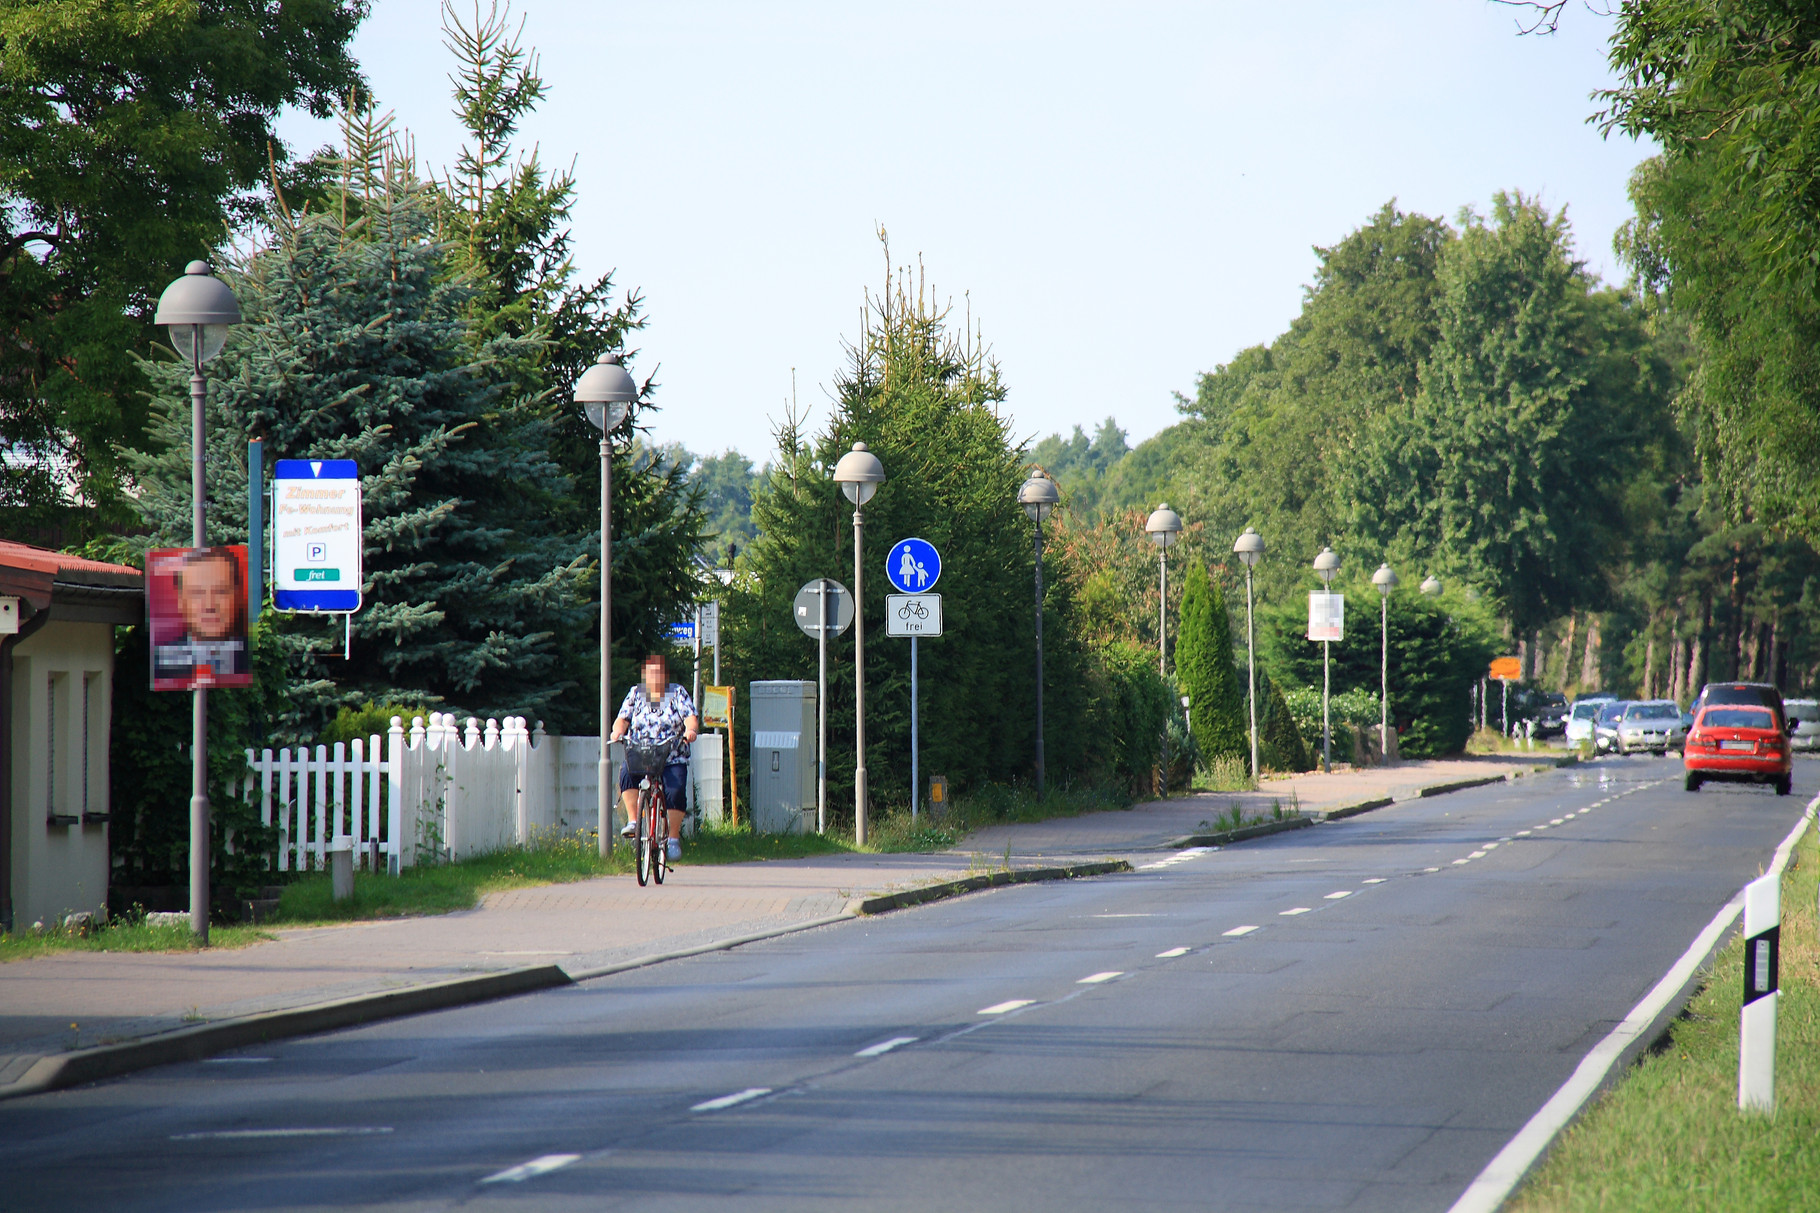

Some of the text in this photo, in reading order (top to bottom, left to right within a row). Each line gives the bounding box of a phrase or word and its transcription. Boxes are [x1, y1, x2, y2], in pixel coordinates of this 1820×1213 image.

[286, 486, 346, 499] Zimmer
[279, 504, 354, 516] Fe-Wohnung
[283, 522, 349, 538] mit Komfort
[312, 547, 321, 557] P
[905, 622, 923, 631] frei
